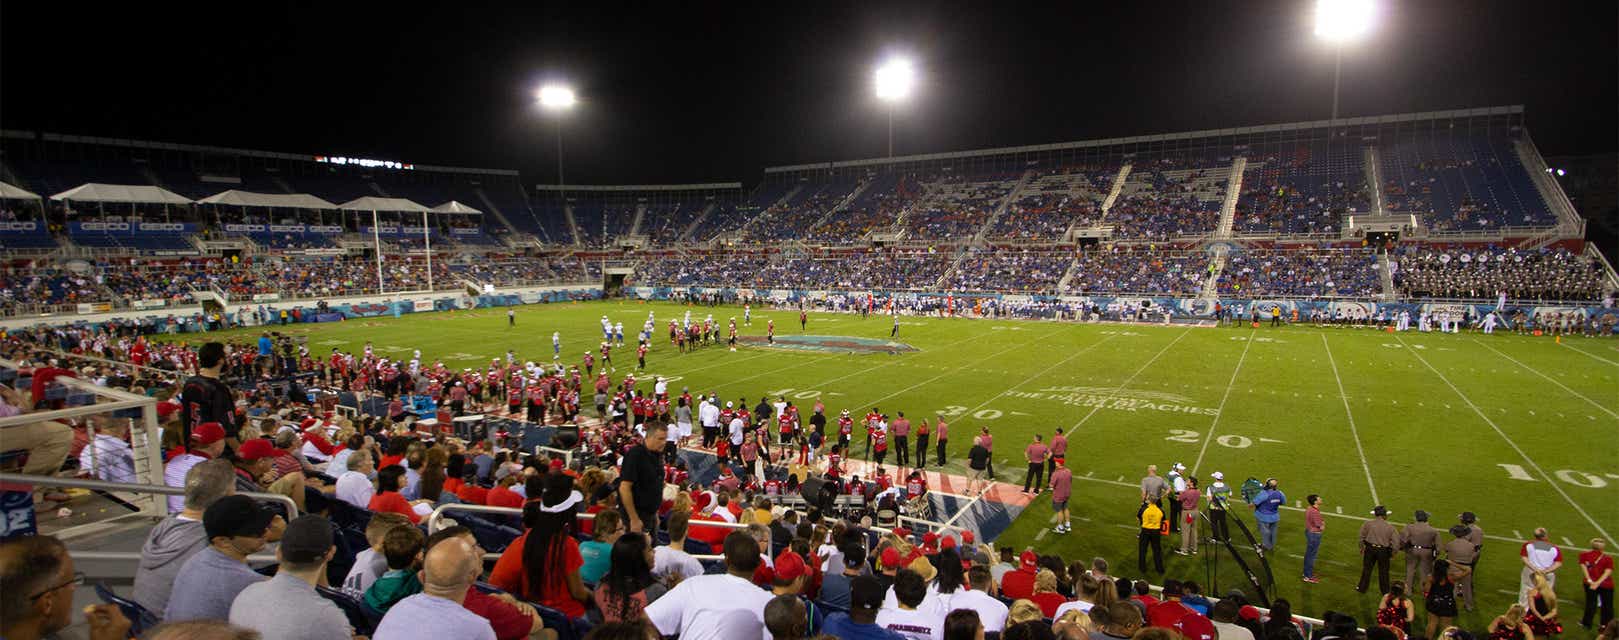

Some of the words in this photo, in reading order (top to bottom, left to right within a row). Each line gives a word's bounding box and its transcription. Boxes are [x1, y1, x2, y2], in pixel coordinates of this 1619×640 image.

[0, 222, 36, 231] EICO
[81, 222, 129, 231] GEICO
[139, 222, 184, 231] GEICO
[226, 224, 265, 232] GEICO
[270, 225, 305, 233] GEICO
[934, 405, 1003, 420] 30
[1164, 429, 1250, 449] 20
[1496, 463, 1609, 488] 10
